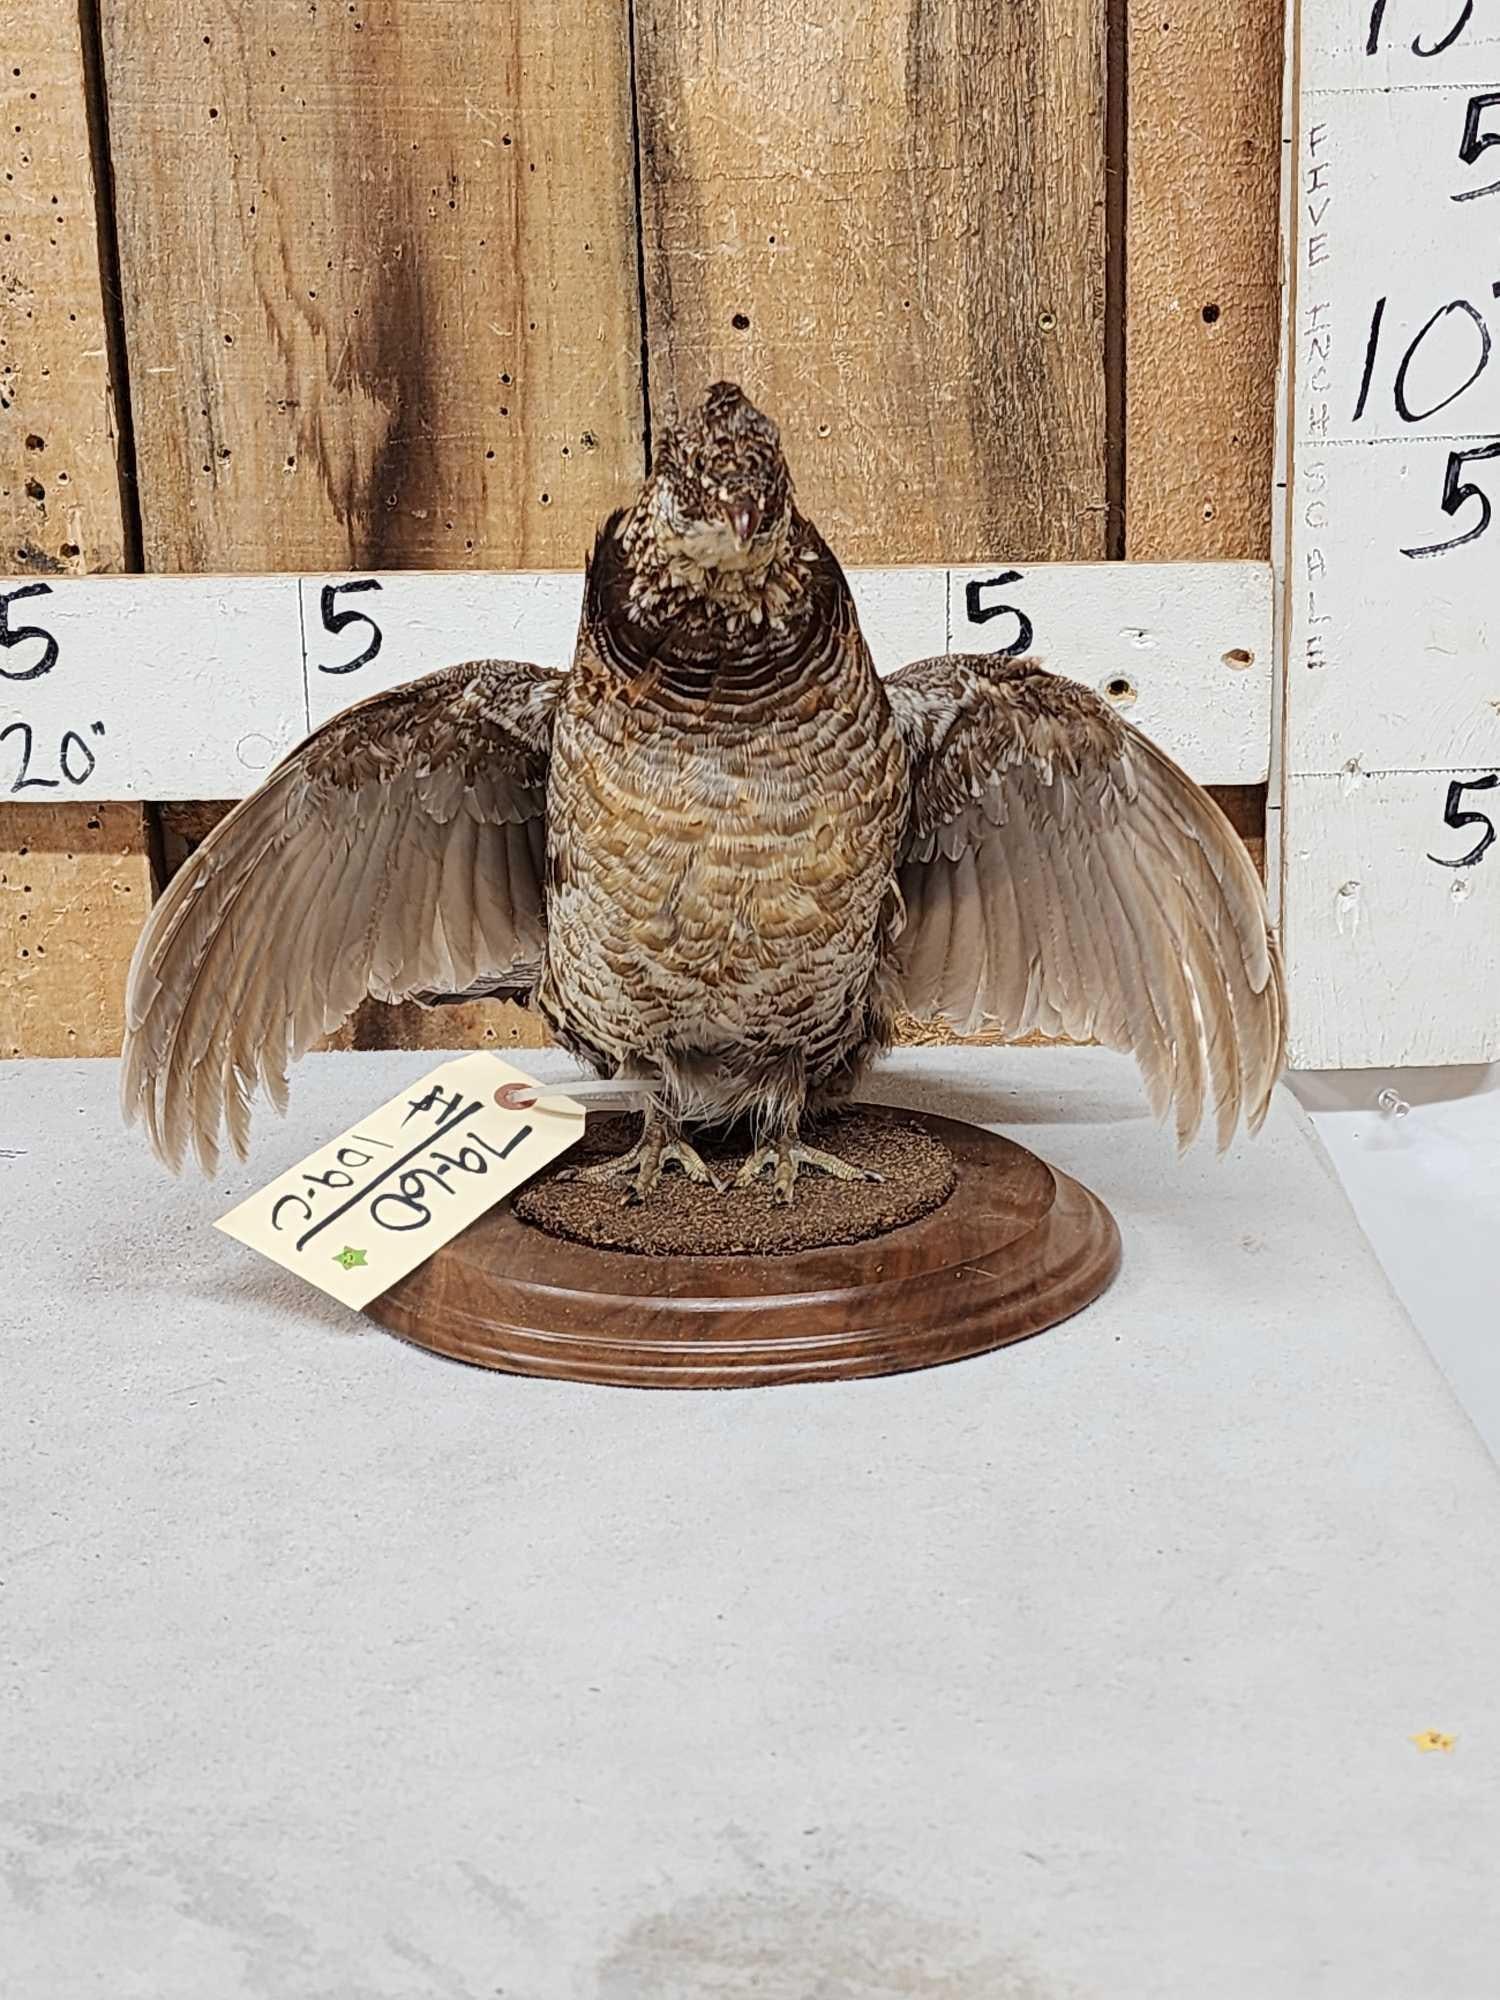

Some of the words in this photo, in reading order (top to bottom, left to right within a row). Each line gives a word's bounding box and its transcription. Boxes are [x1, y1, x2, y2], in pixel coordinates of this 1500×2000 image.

[1307, 122, 1331, 268] FIVE
[1400, 442, 1500, 558] 5
[0, 582, 60, 681] 5
[318, 578, 384, 675] 5
[965, 569, 1034, 657] 5
[1426, 773, 1500, 868] 5
